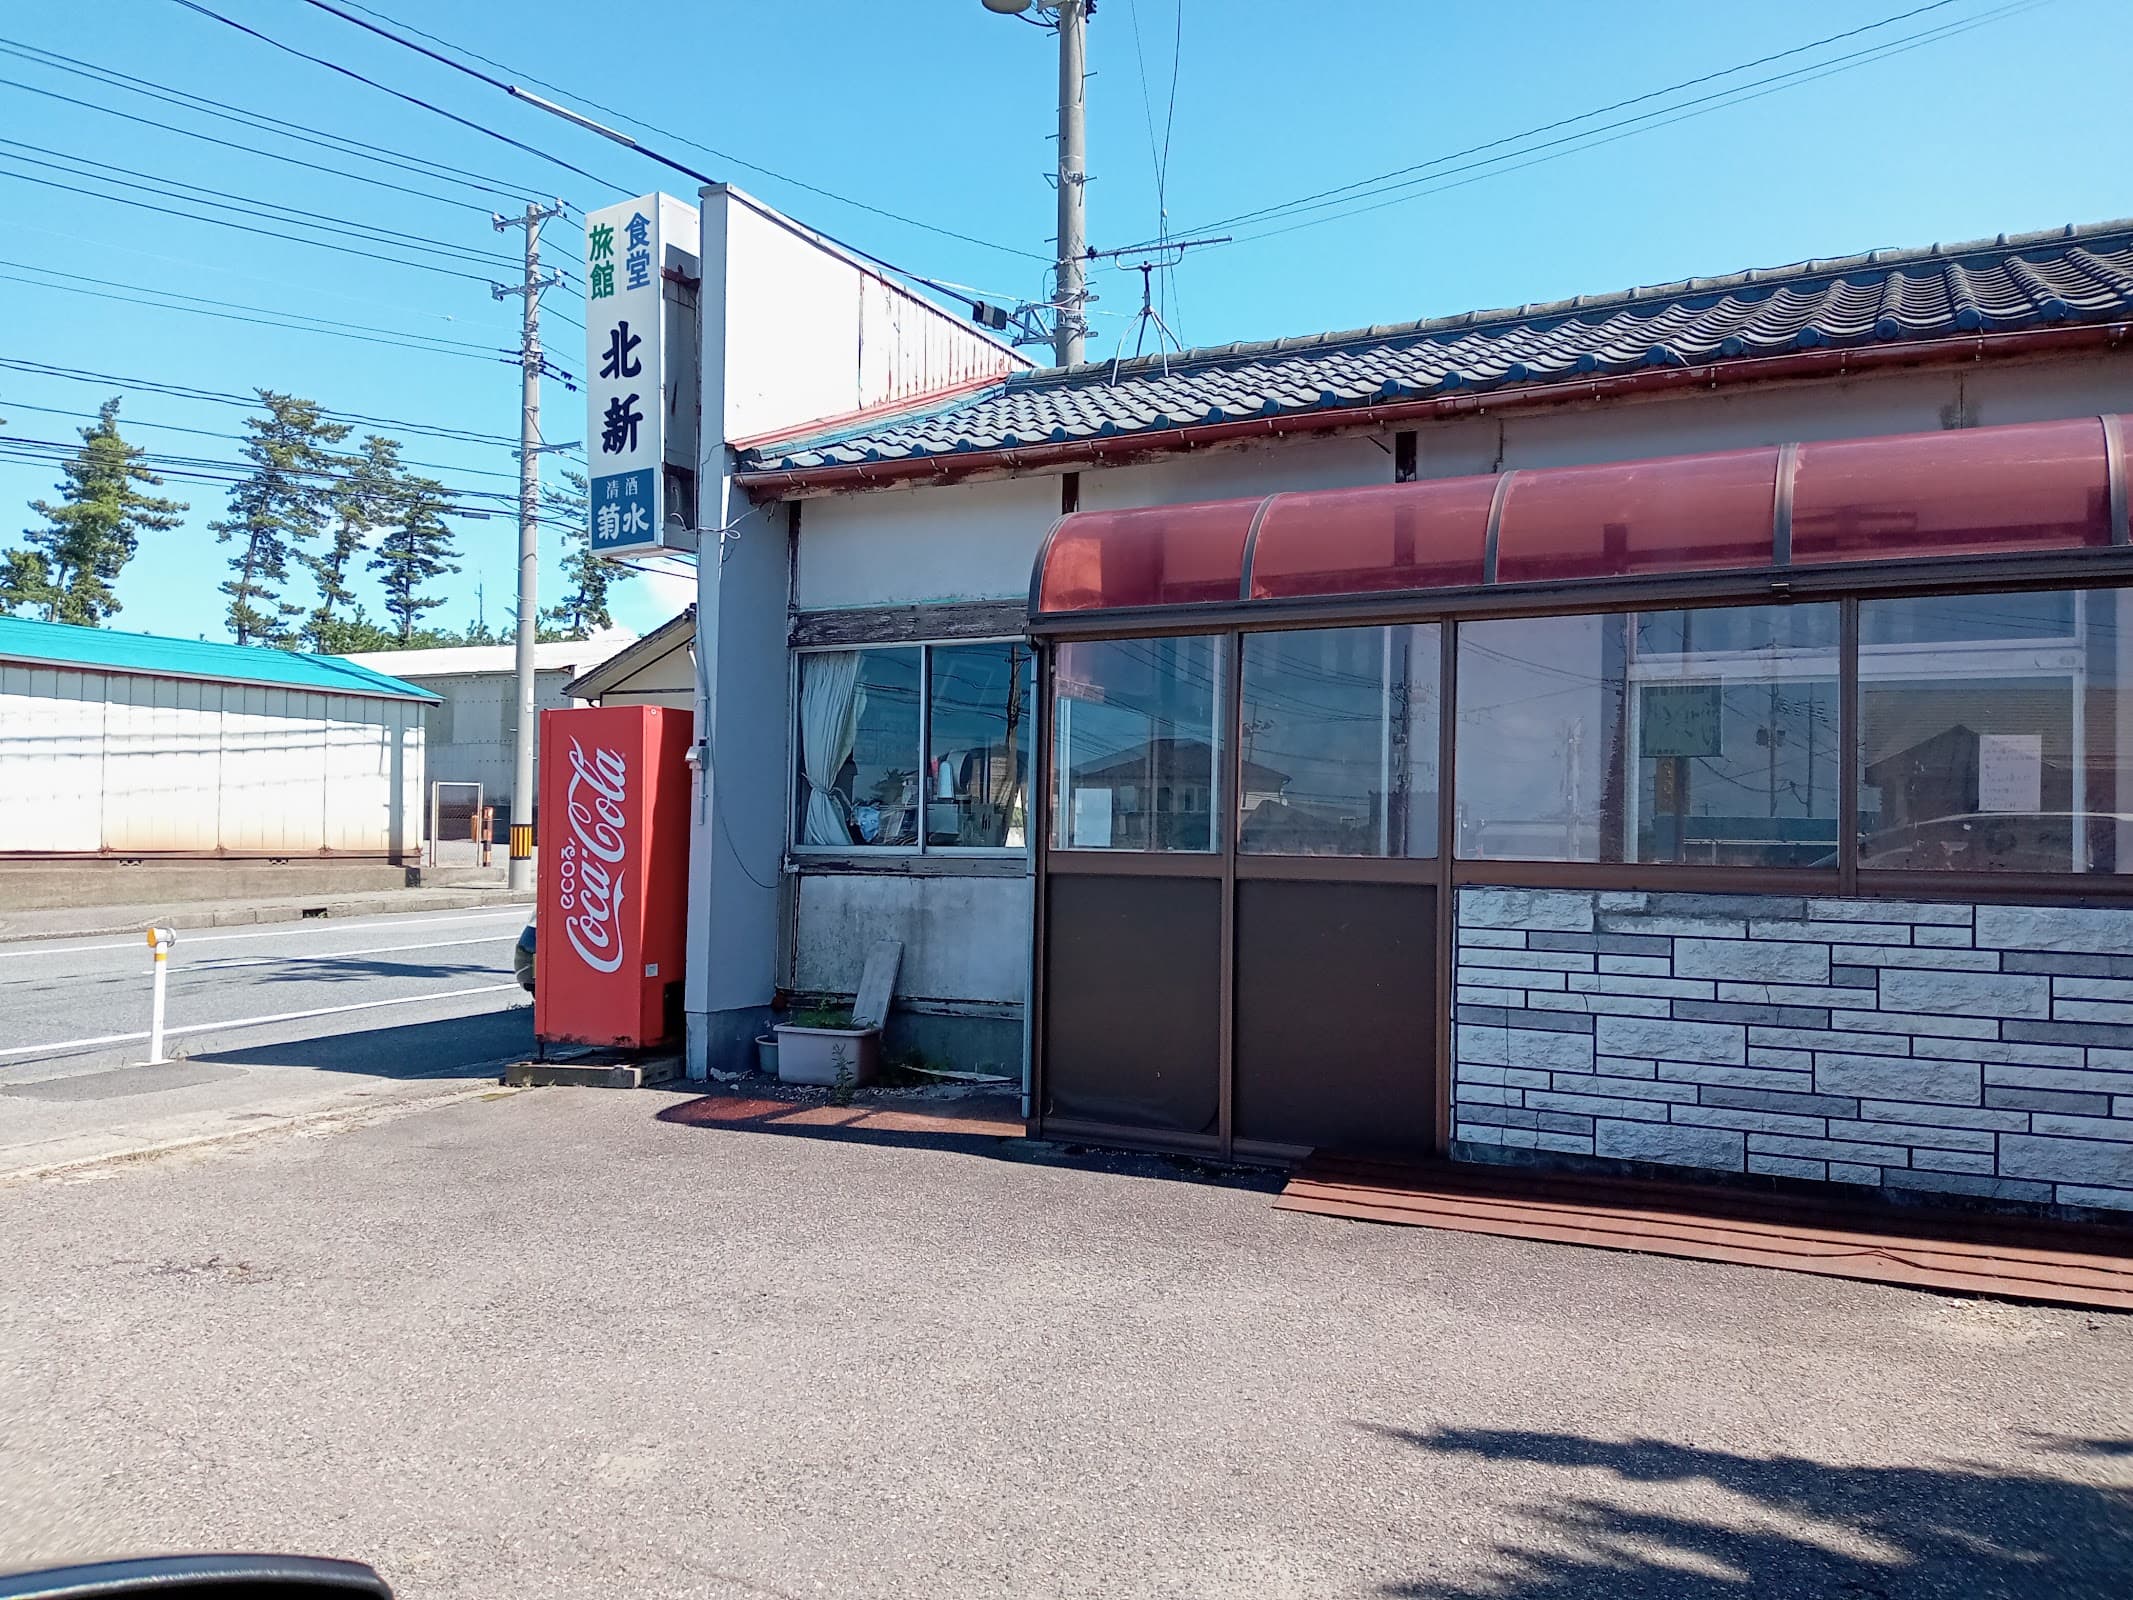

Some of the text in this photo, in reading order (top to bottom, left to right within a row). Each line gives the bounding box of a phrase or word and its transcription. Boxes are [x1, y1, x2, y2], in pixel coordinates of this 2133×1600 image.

[589, 223, 615, 301] 旅館
[625, 212, 651, 291] 食堂
[600, 321, 643, 455] 北新
[597, 501, 650, 541] 菊水
[606, 476, 639, 500] 清酒
[566, 735, 626, 974] Coca-Cola
